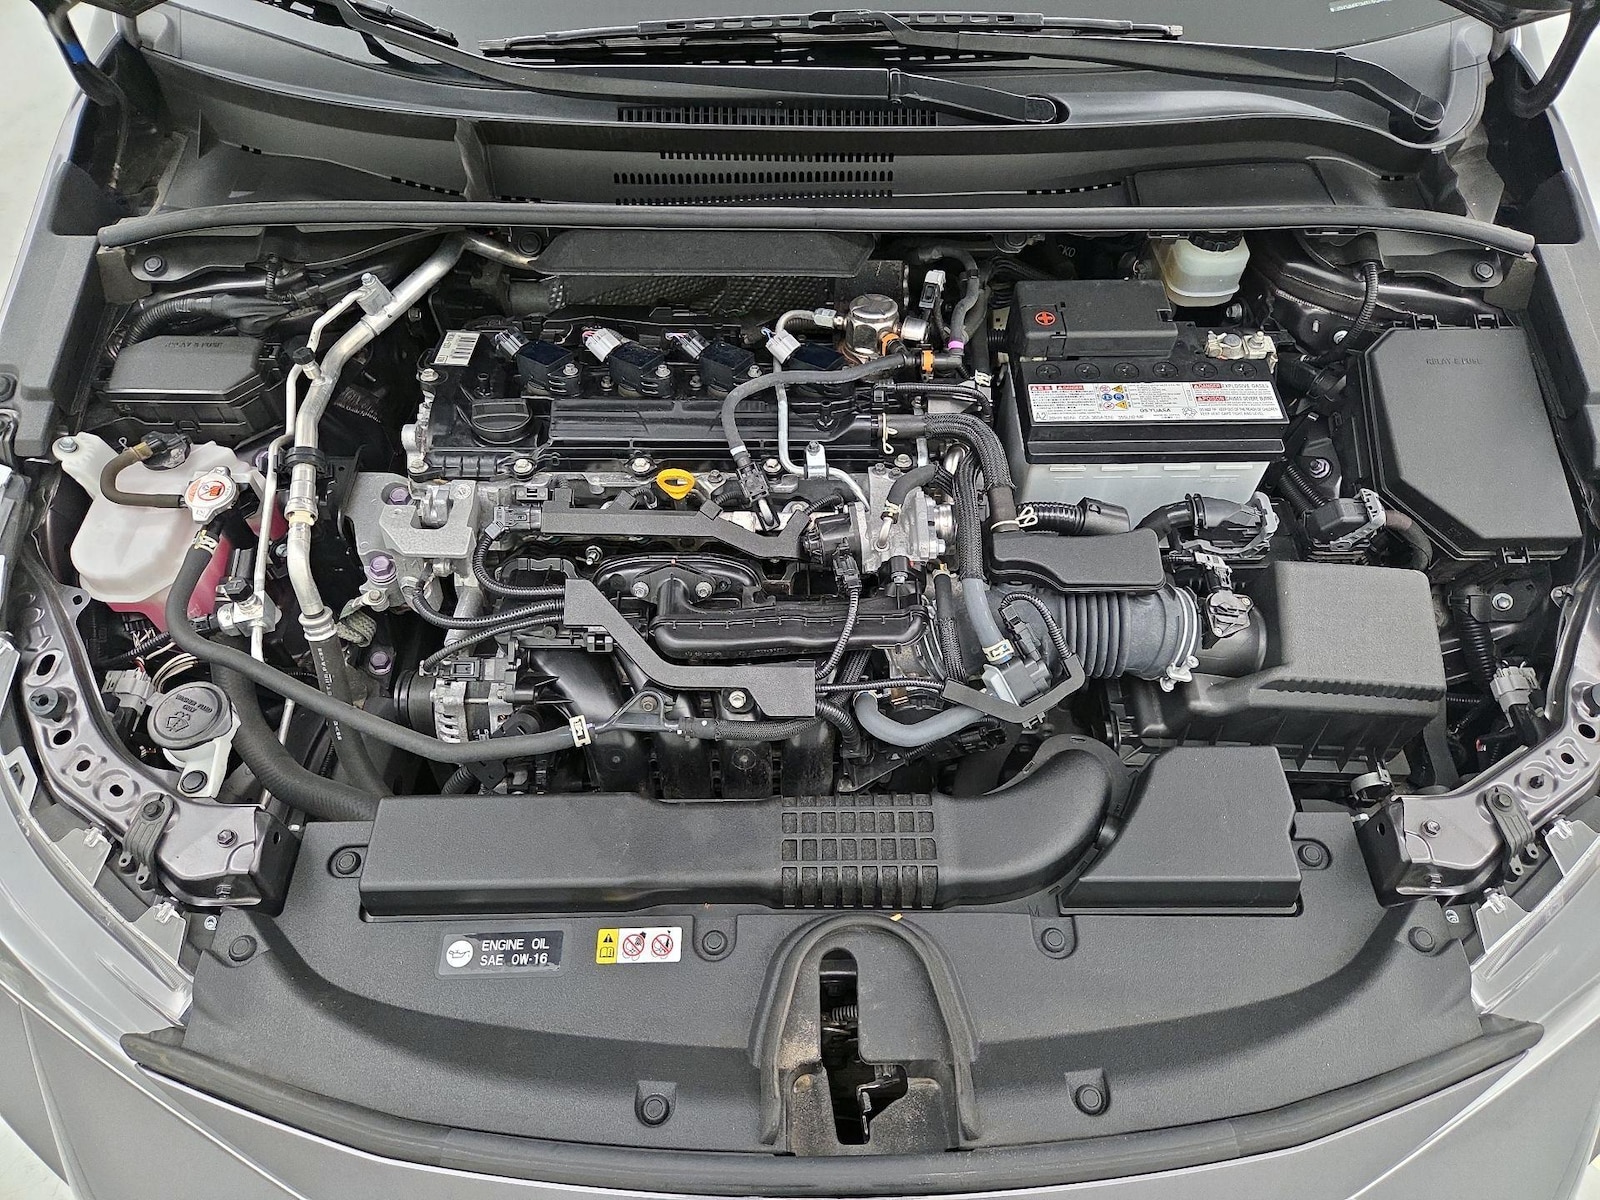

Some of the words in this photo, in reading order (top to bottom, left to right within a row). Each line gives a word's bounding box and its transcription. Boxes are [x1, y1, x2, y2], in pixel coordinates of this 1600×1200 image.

[482, 938, 524, 951] ENGINE
[532, 937, 550, 950] OIL
[480, 954, 504, 966] SAE
[511, 952, 548, 966] 0W-16
